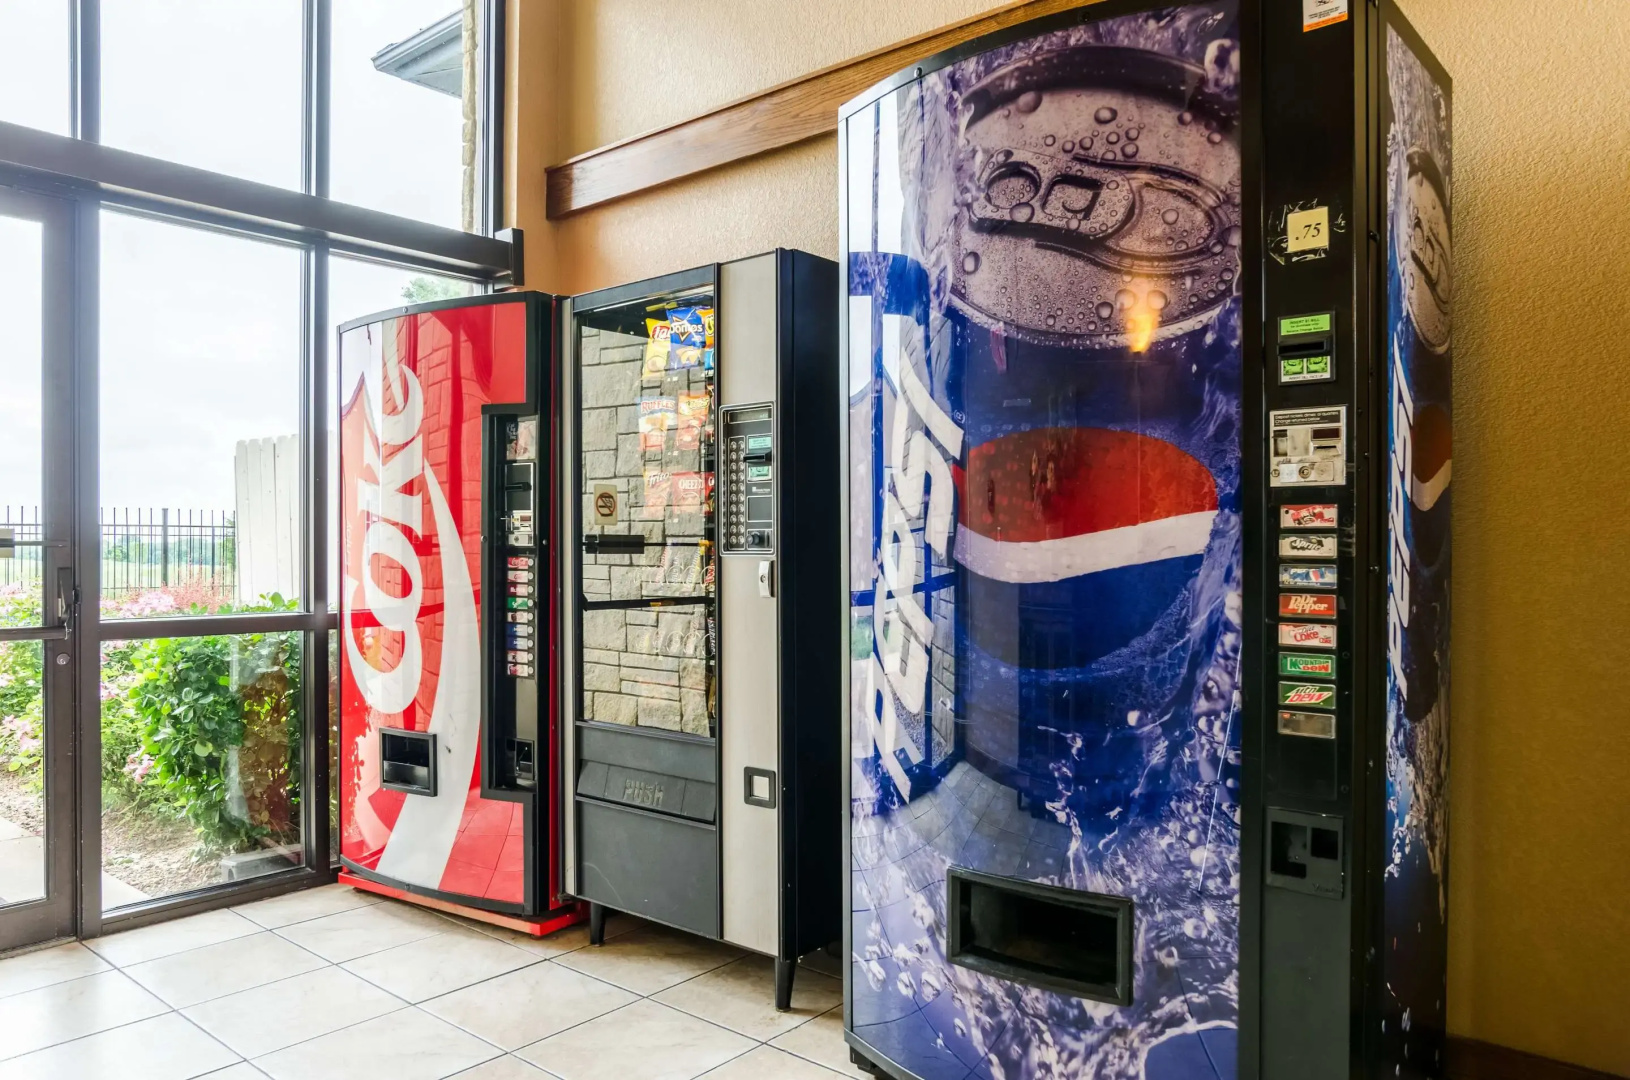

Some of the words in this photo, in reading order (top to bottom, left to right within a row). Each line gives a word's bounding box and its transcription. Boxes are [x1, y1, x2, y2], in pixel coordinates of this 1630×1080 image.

[1294, 222, 1321, 241] .75
[641, 399, 676, 413] RUFFLES
[1389, 331, 1414, 701] PEPSI
[345, 362, 425, 715] Coke
[1291, 538, 1322, 551] Sprite
[866, 347, 965, 805] PEPSI
[1288, 595, 1328, 613] Pepper
[1301, 594, 1317, 604] Dr
[1293, 630, 1319, 643] Coke
[624, 777, 665, 808] PUSH
